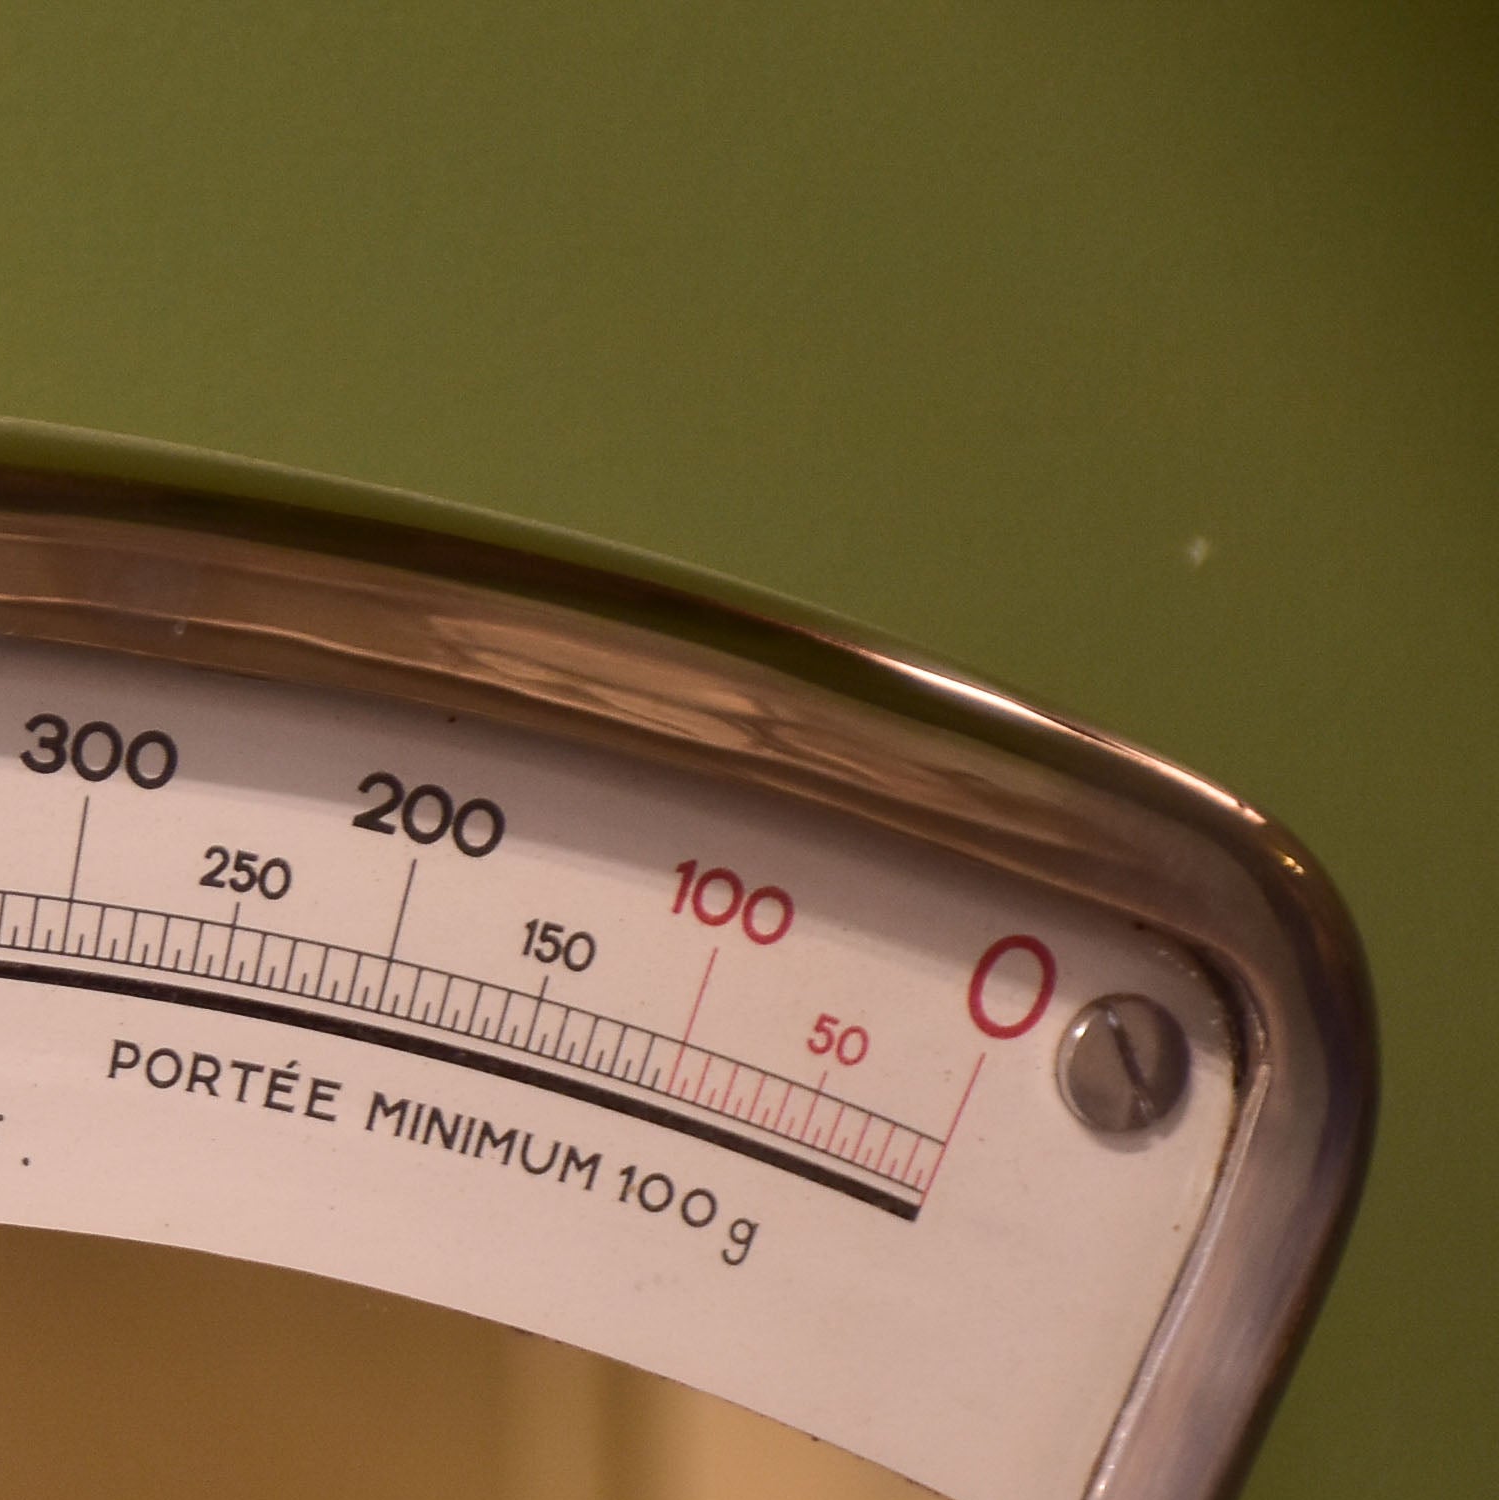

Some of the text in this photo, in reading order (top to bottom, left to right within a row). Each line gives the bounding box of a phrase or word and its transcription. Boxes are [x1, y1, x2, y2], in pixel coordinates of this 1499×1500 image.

[20, 714, 177, 789] 300
[353, 773, 505, 857] 200
[199, 846, 291, 900] 250
[672, 860, 793, 945] 100
[522, 919, 595, 972] 150
[968, 936, 1054, 1039] 0
[807, 1014, 869, 1066] 50
[107, 1039, 343, 1122] PORTÉE
[364, 1090, 603, 1191] MINIMUM
